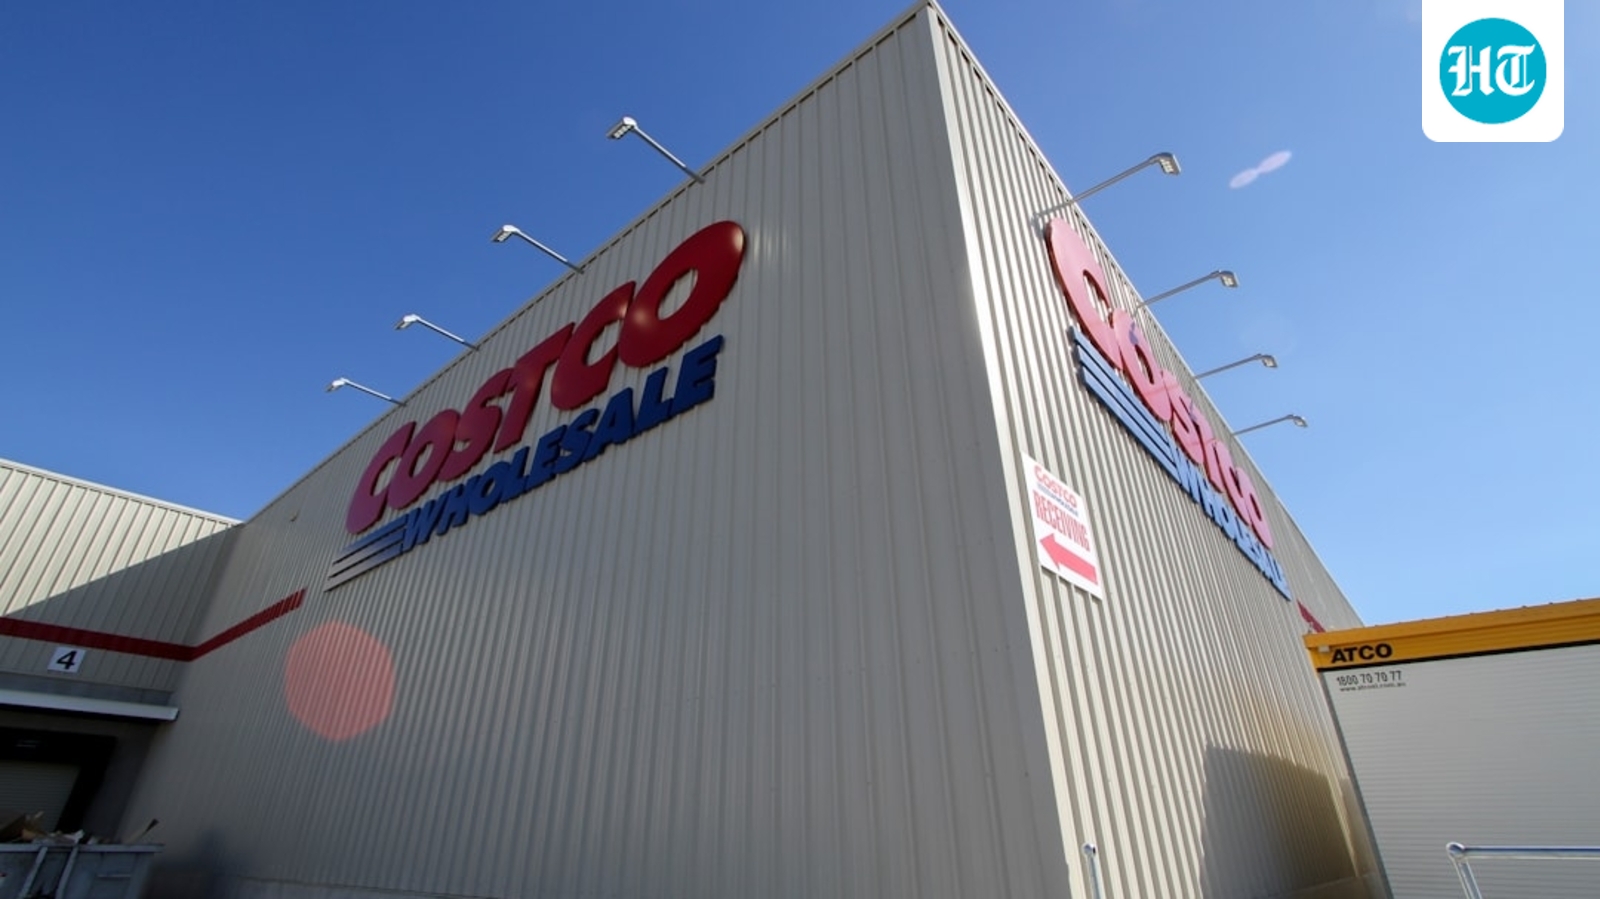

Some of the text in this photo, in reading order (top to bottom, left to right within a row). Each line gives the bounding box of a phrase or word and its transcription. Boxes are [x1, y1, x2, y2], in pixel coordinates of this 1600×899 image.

[346, 220, 747, 535] COSTCO
[1045, 217, 1273, 549] COSTCO
[401, 334, 724, 552] WHOLESALE
[1034, 465, 1077, 508] COSTCO
[1033, 490, 1090, 551] RECEIVING
[1173, 446, 1292, 601] WHOLESALE
[56, 650, 76, 670] 4
[1331, 644, 1393, 663] ATCO
[1337, 670, 1402, 686] 1800 70 70 77
